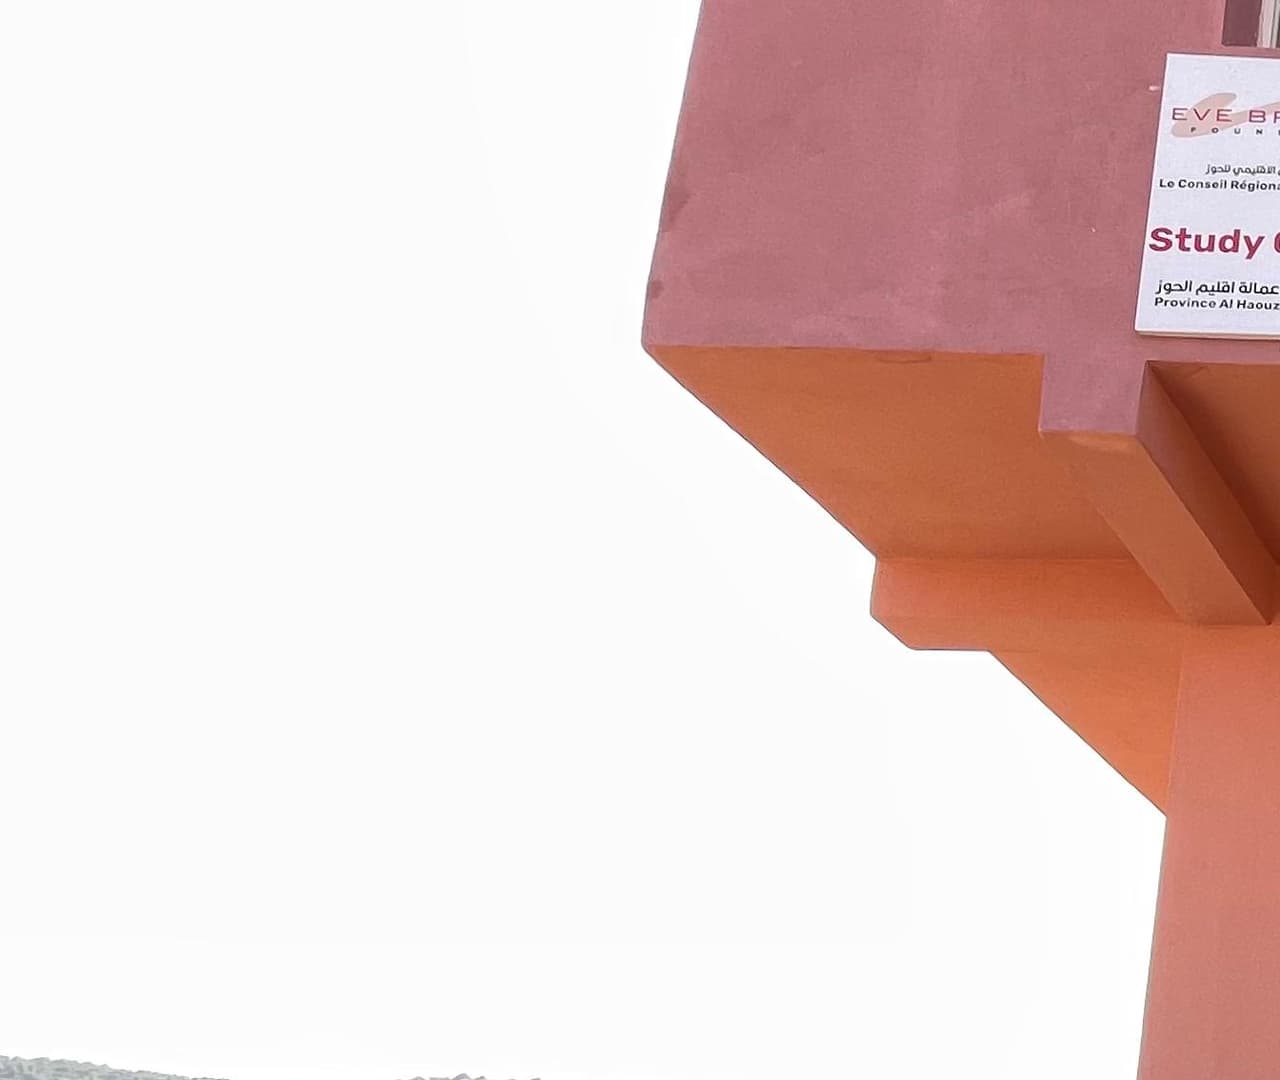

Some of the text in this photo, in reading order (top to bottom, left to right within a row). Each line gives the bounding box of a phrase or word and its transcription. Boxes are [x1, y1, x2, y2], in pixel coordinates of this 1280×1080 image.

[1172, 108, 1233, 122] EVE
[1159, 179, 1175, 188] Le
[1178, 179, 1227, 190] Conseil
[1149, 228, 1265, 259] Study
[1155, 280, 1192, 296] الحوز
[1240, 281, 1280, 295] عمالة
[1154, 297, 1280, 311] Province Al Haouz
